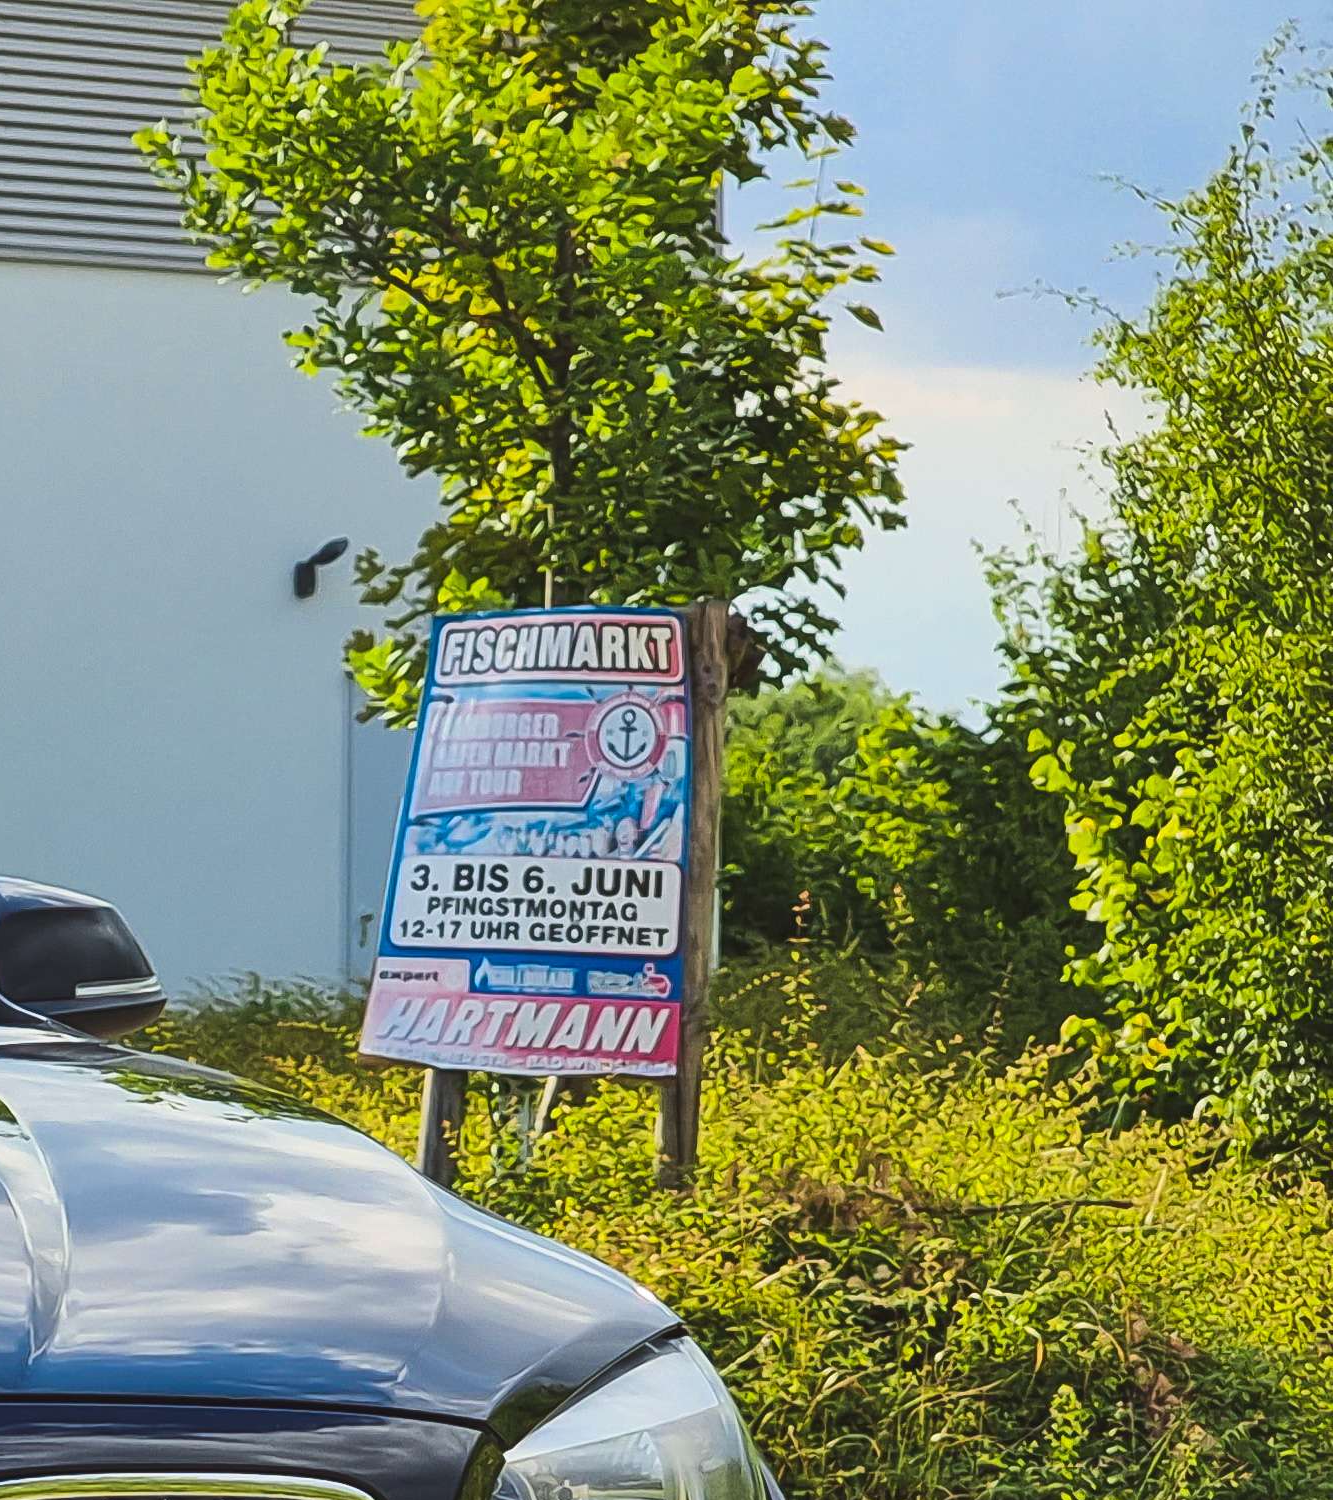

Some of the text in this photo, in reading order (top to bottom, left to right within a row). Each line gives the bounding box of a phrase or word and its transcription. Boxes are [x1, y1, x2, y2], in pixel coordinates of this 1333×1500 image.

[440, 624, 672, 674] FISCHMARKT
[410, 863, 664, 898] 3. BIS 6. JUNI
[427, 896, 639, 922] PFINGSTMONTAG
[399, 917, 670, 947] 12-17 UHR GEÖFFNET
[375, 998, 671, 1055] HARTMANN
